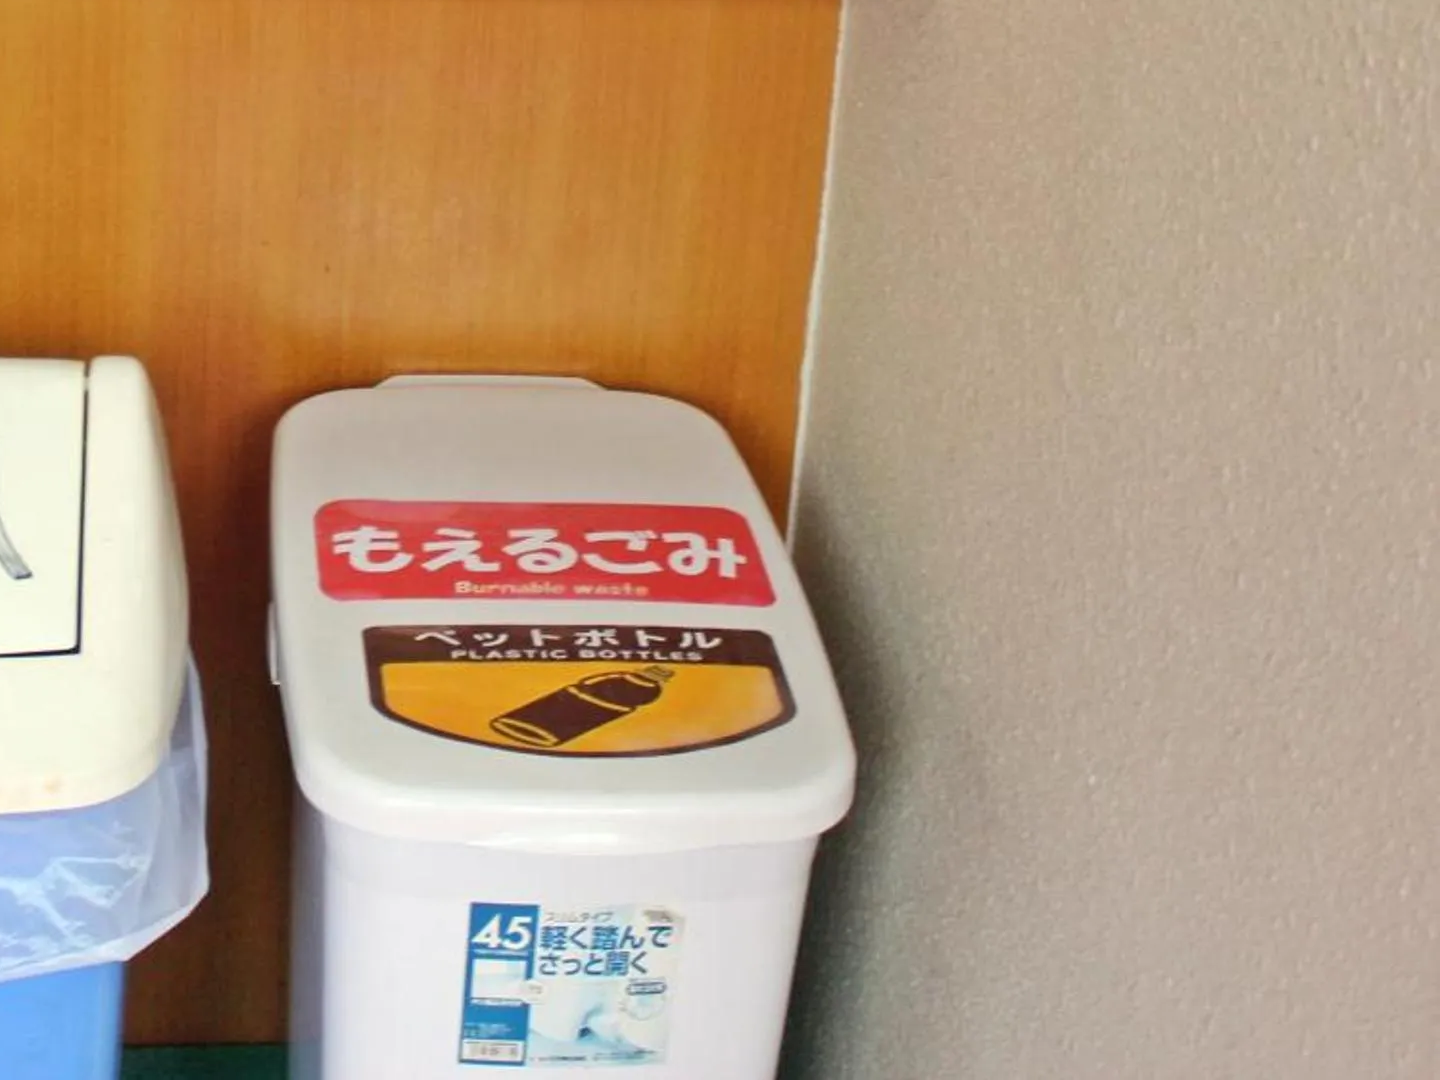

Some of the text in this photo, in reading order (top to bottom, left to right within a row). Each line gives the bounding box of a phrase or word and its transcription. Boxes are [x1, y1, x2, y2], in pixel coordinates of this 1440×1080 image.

[331, 525, 748, 579] もえるごみ
[453, 580, 650, 597] Burnable waste
[450, 648, 704, 661] PLASTIC BOTTLES
[471, 913, 533, 950] 45
[539, 925, 673, 951] 軽く踏んで
[538, 950, 649, 976] さっと開く
